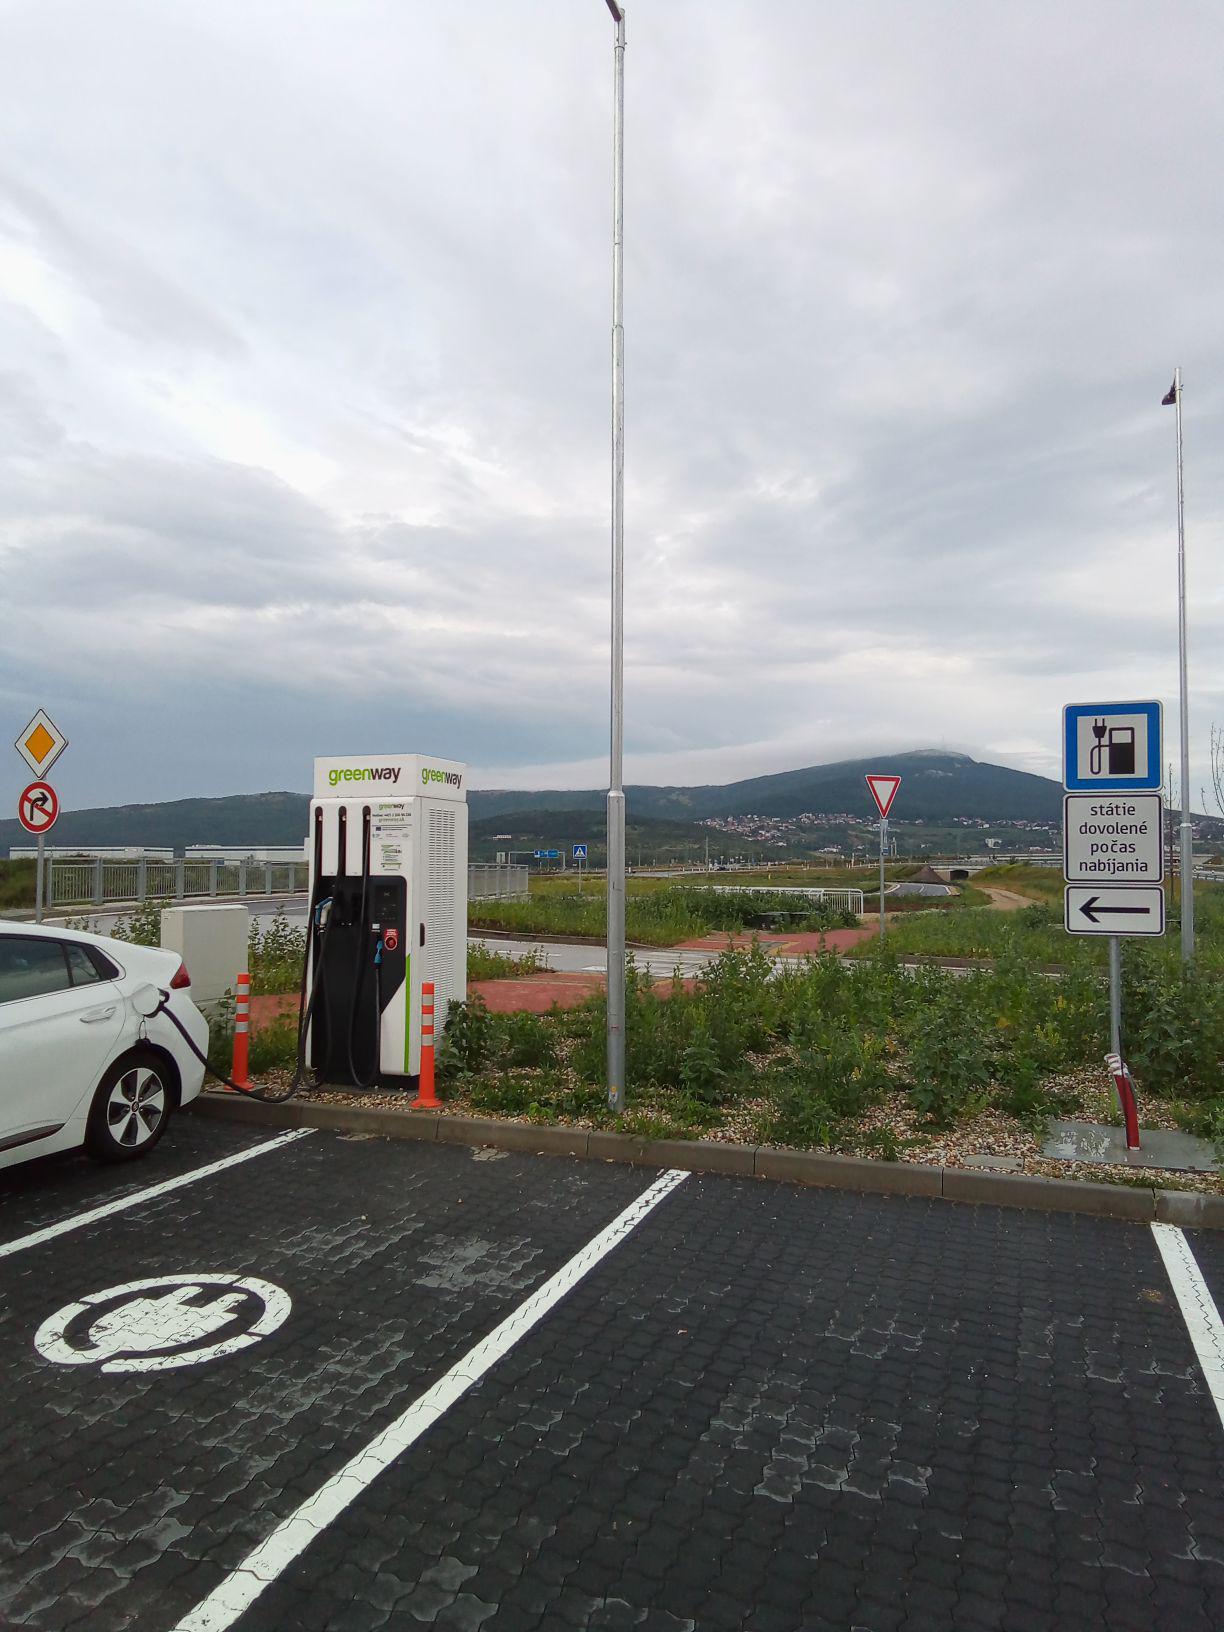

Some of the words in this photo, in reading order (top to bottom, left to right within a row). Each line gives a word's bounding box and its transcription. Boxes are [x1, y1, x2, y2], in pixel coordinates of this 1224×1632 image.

[329, 767, 401, 786] greenway
[421, 768, 462, 789] greenway
[1090, 802, 1136, 816] státie
[1079, 821, 1148, 834] dovolené
[1090, 839, 1136, 855] počas
[1079, 858, 1148, 875] nabíjania
